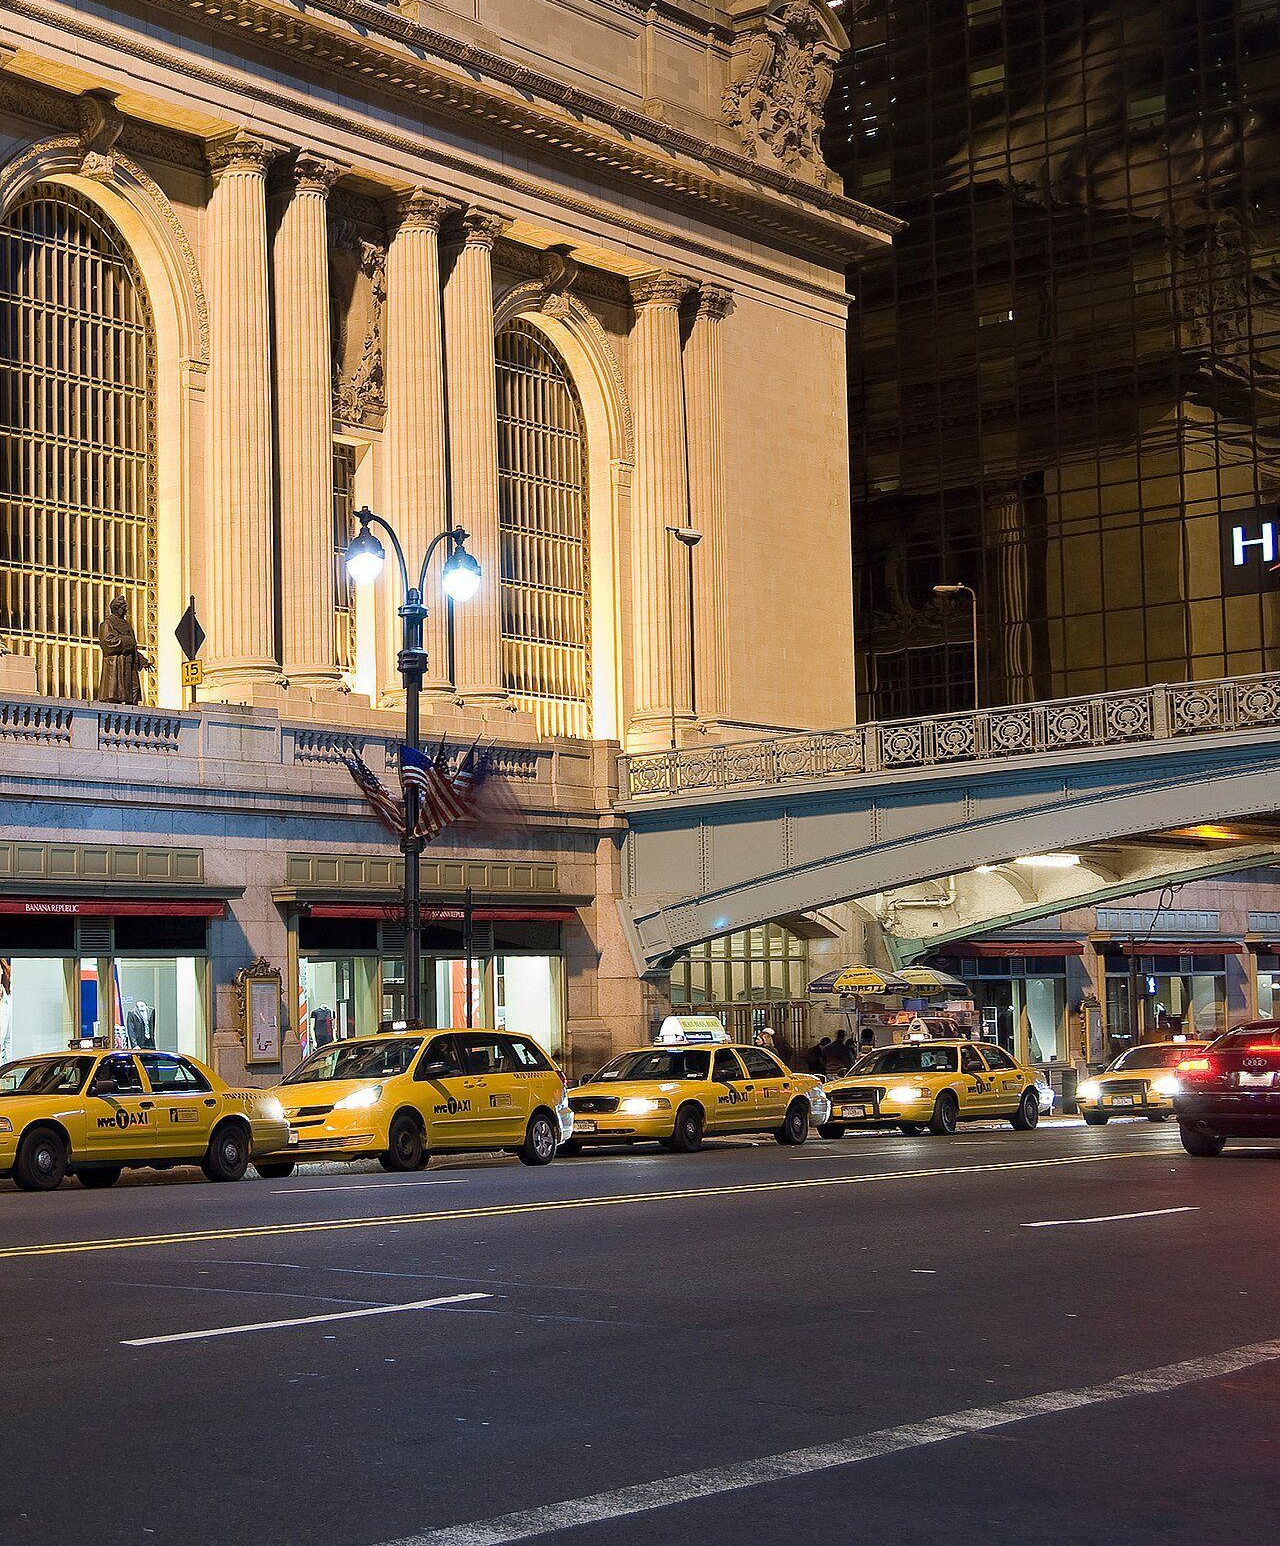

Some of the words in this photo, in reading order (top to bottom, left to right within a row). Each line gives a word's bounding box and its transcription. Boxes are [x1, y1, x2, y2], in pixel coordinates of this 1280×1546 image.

[26, 904, 51, 912] BANANA
[51, 904, 80, 912] REPUBLIC
[433, 1105, 447, 1114] NYC
[446, 1096, 471, 1114] TAXI
[97, 1117, 116, 1127] NYC
[115, 1109, 149, 1129] TAXI
